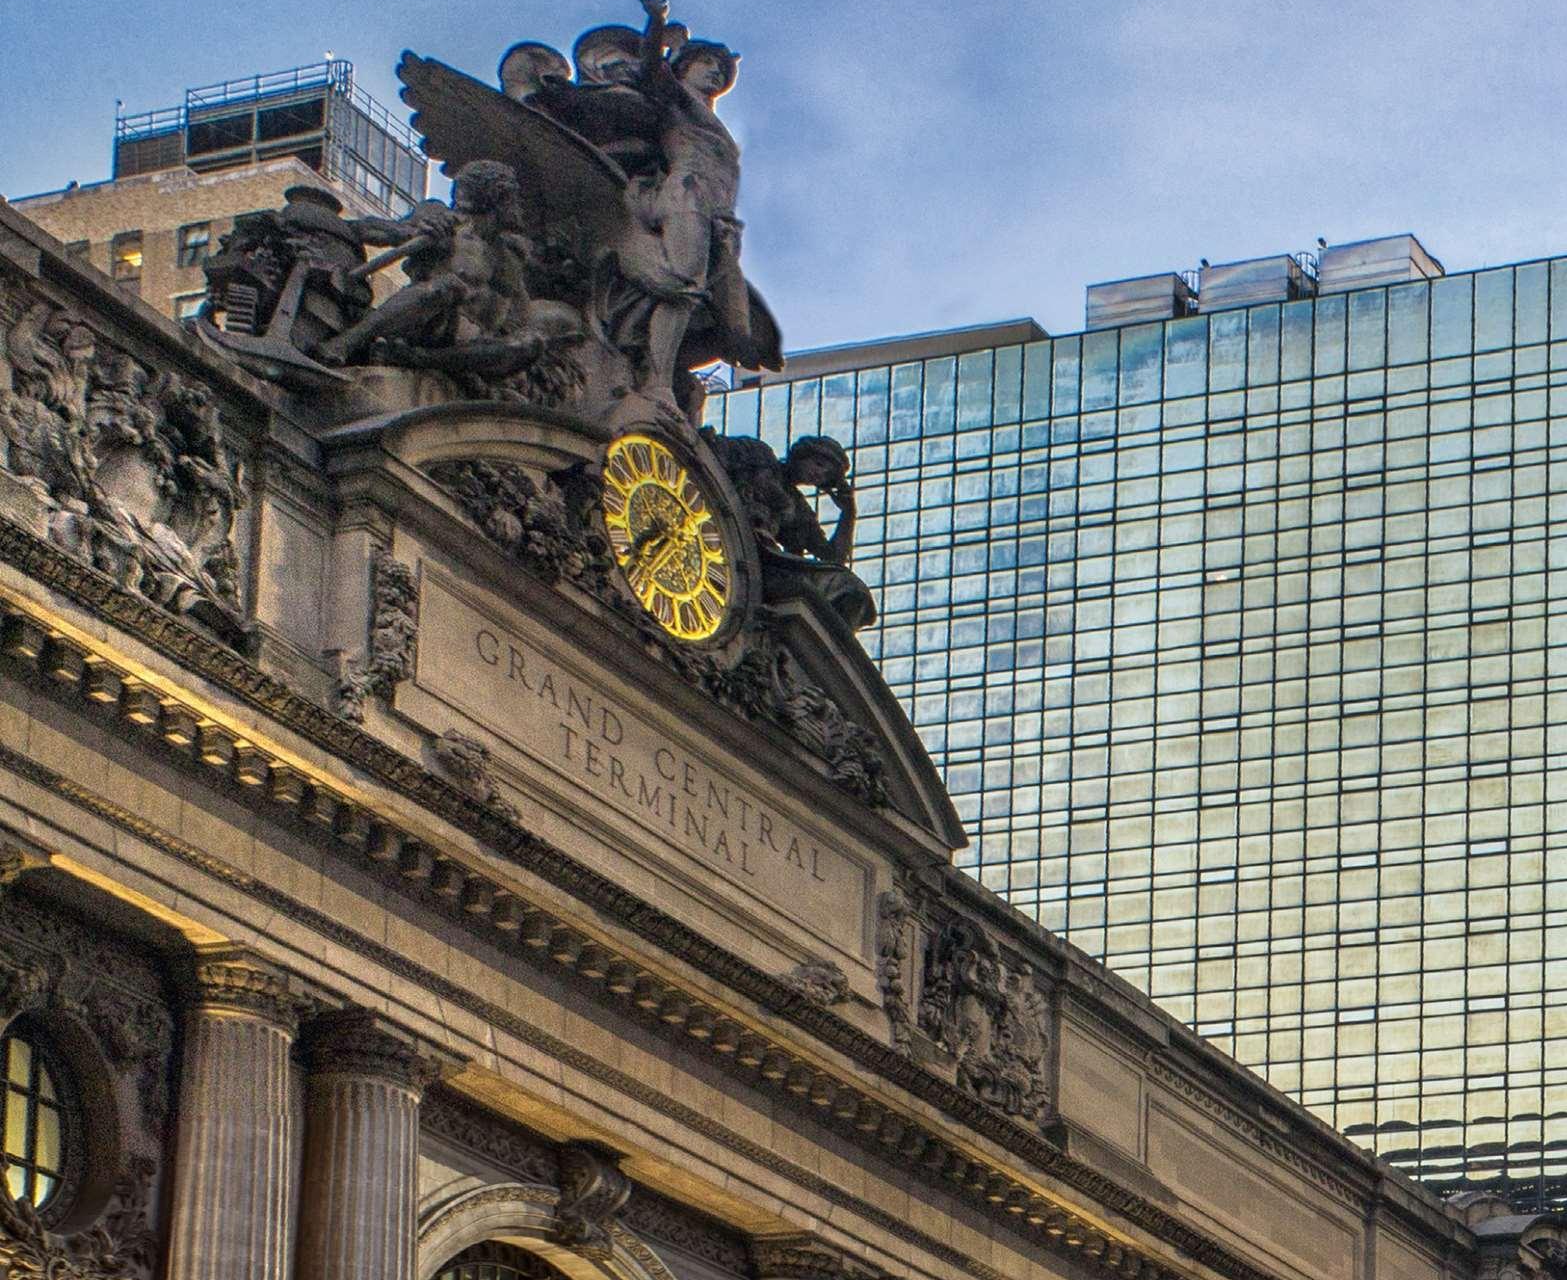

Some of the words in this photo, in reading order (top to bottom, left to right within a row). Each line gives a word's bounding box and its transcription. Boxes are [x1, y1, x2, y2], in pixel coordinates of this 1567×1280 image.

[475, 629, 624, 746] GRAND
[654, 747, 826, 883] CENTRAL
[559, 722, 755, 877] TERMINAL
